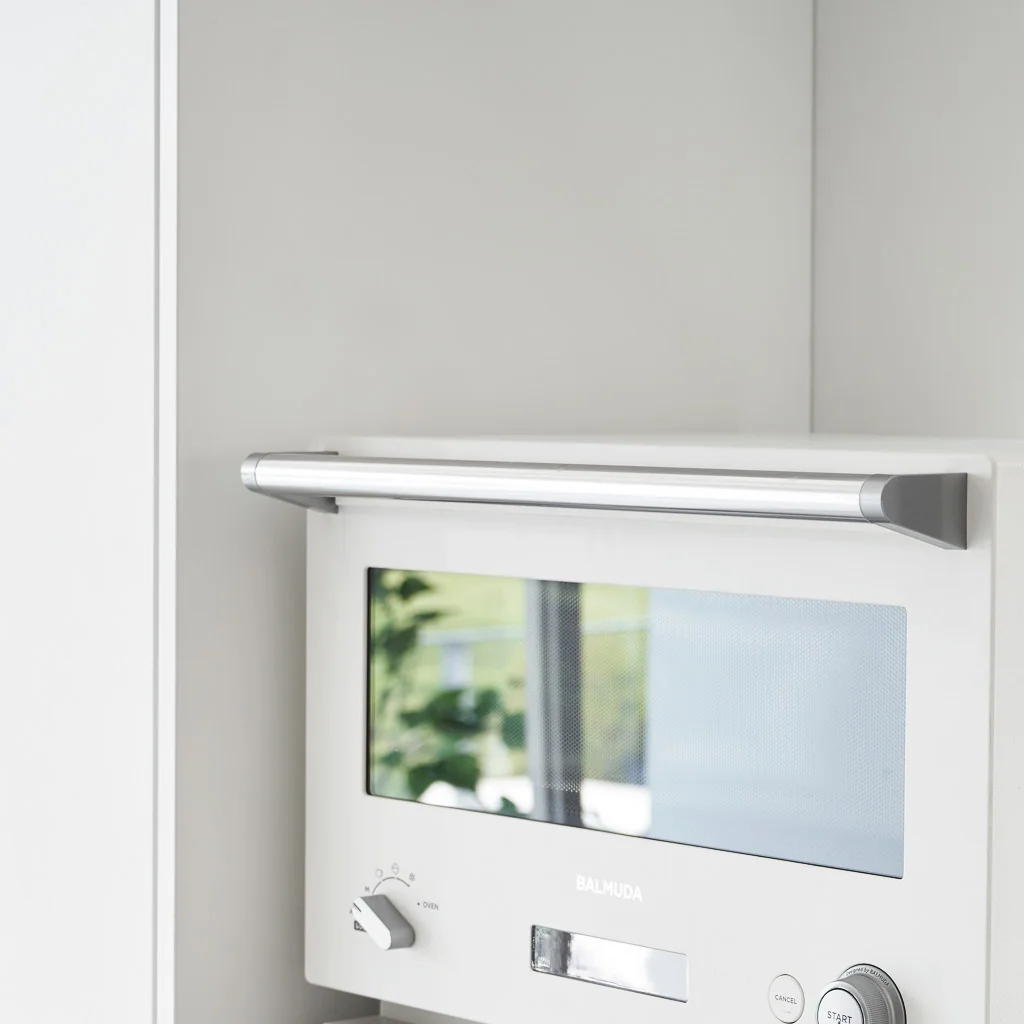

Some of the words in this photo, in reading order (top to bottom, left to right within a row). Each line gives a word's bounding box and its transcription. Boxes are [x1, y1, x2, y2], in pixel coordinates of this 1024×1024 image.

[577, 875, 643, 902] BALMUDA
[422, 902, 438, 911] OVEN
[869, 969, 890, 987] BALMUDA
[774, 994, 797, 1005] CANCEL
[827, 1010, 853, 1024] START
